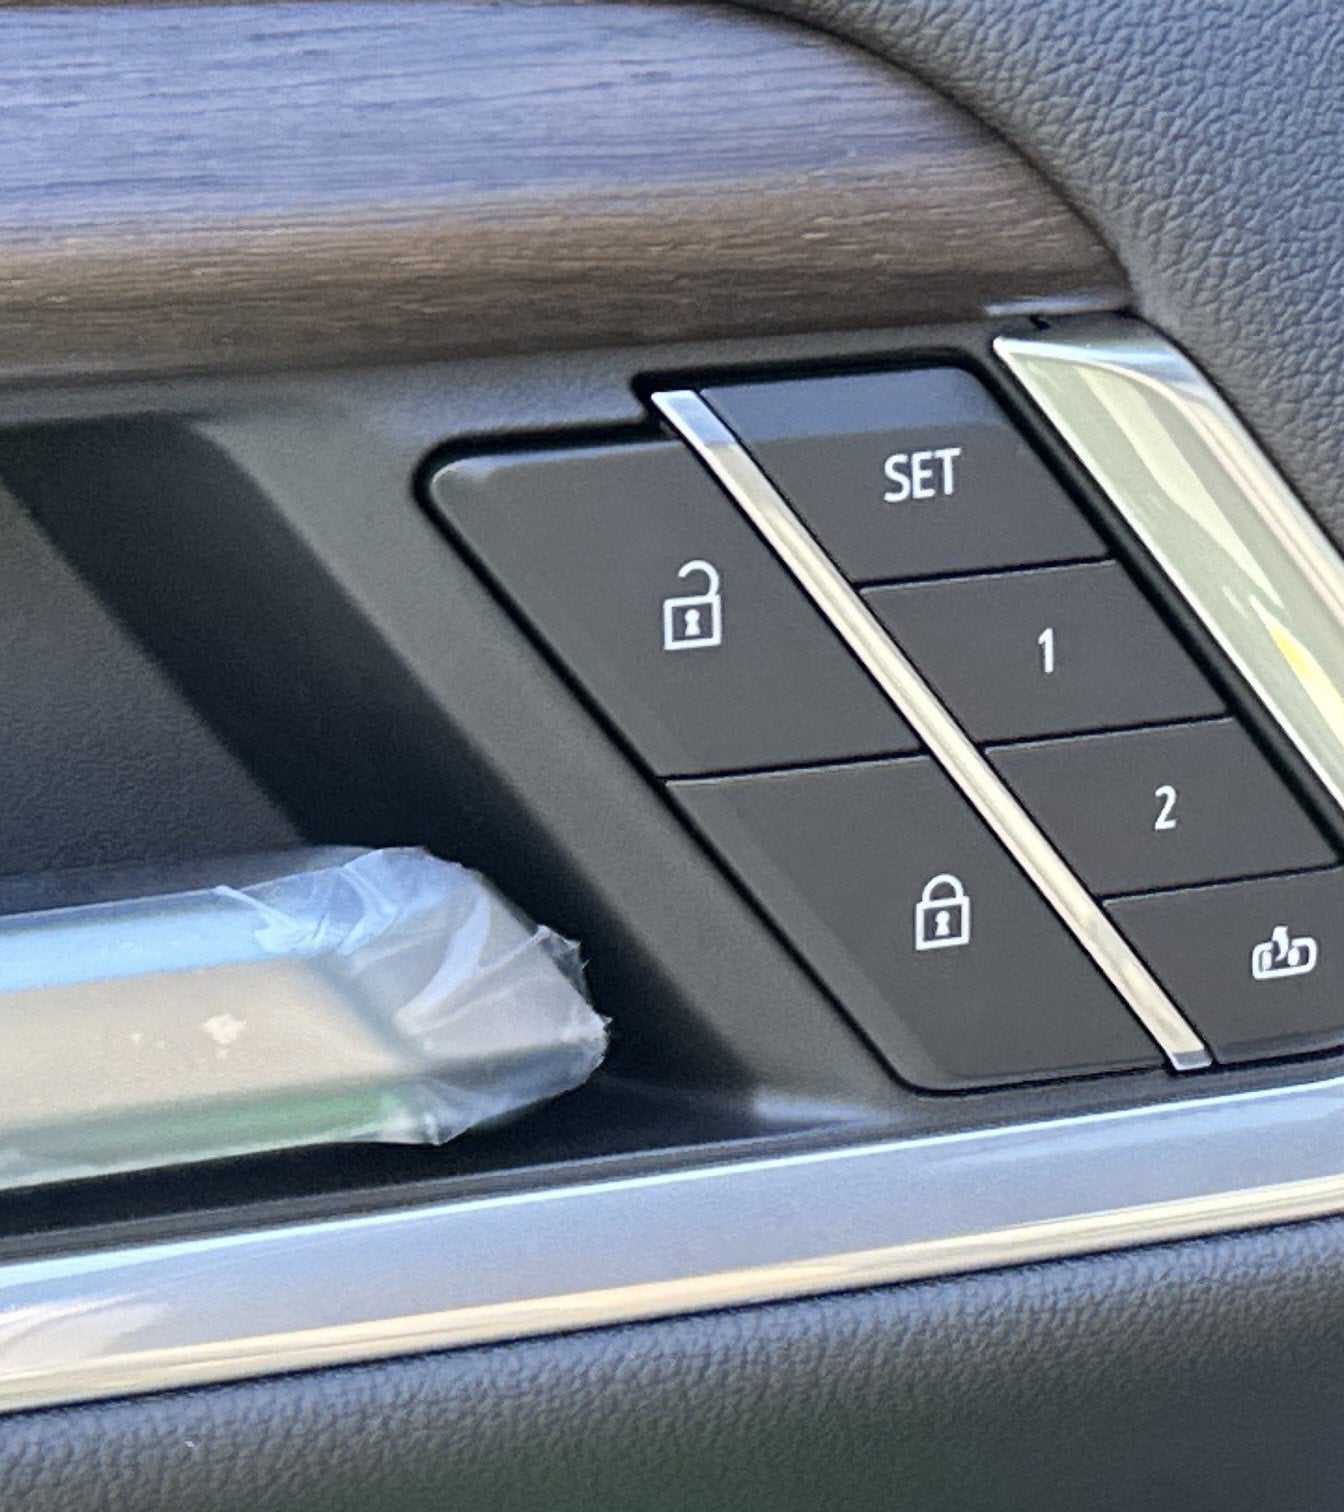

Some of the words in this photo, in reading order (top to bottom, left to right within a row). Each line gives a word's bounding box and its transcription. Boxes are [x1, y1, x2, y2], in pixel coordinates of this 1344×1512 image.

[883, 447, 962, 503] SET
[1037, 627, 1055, 675] 1
[1154, 784, 1177, 831] 2
